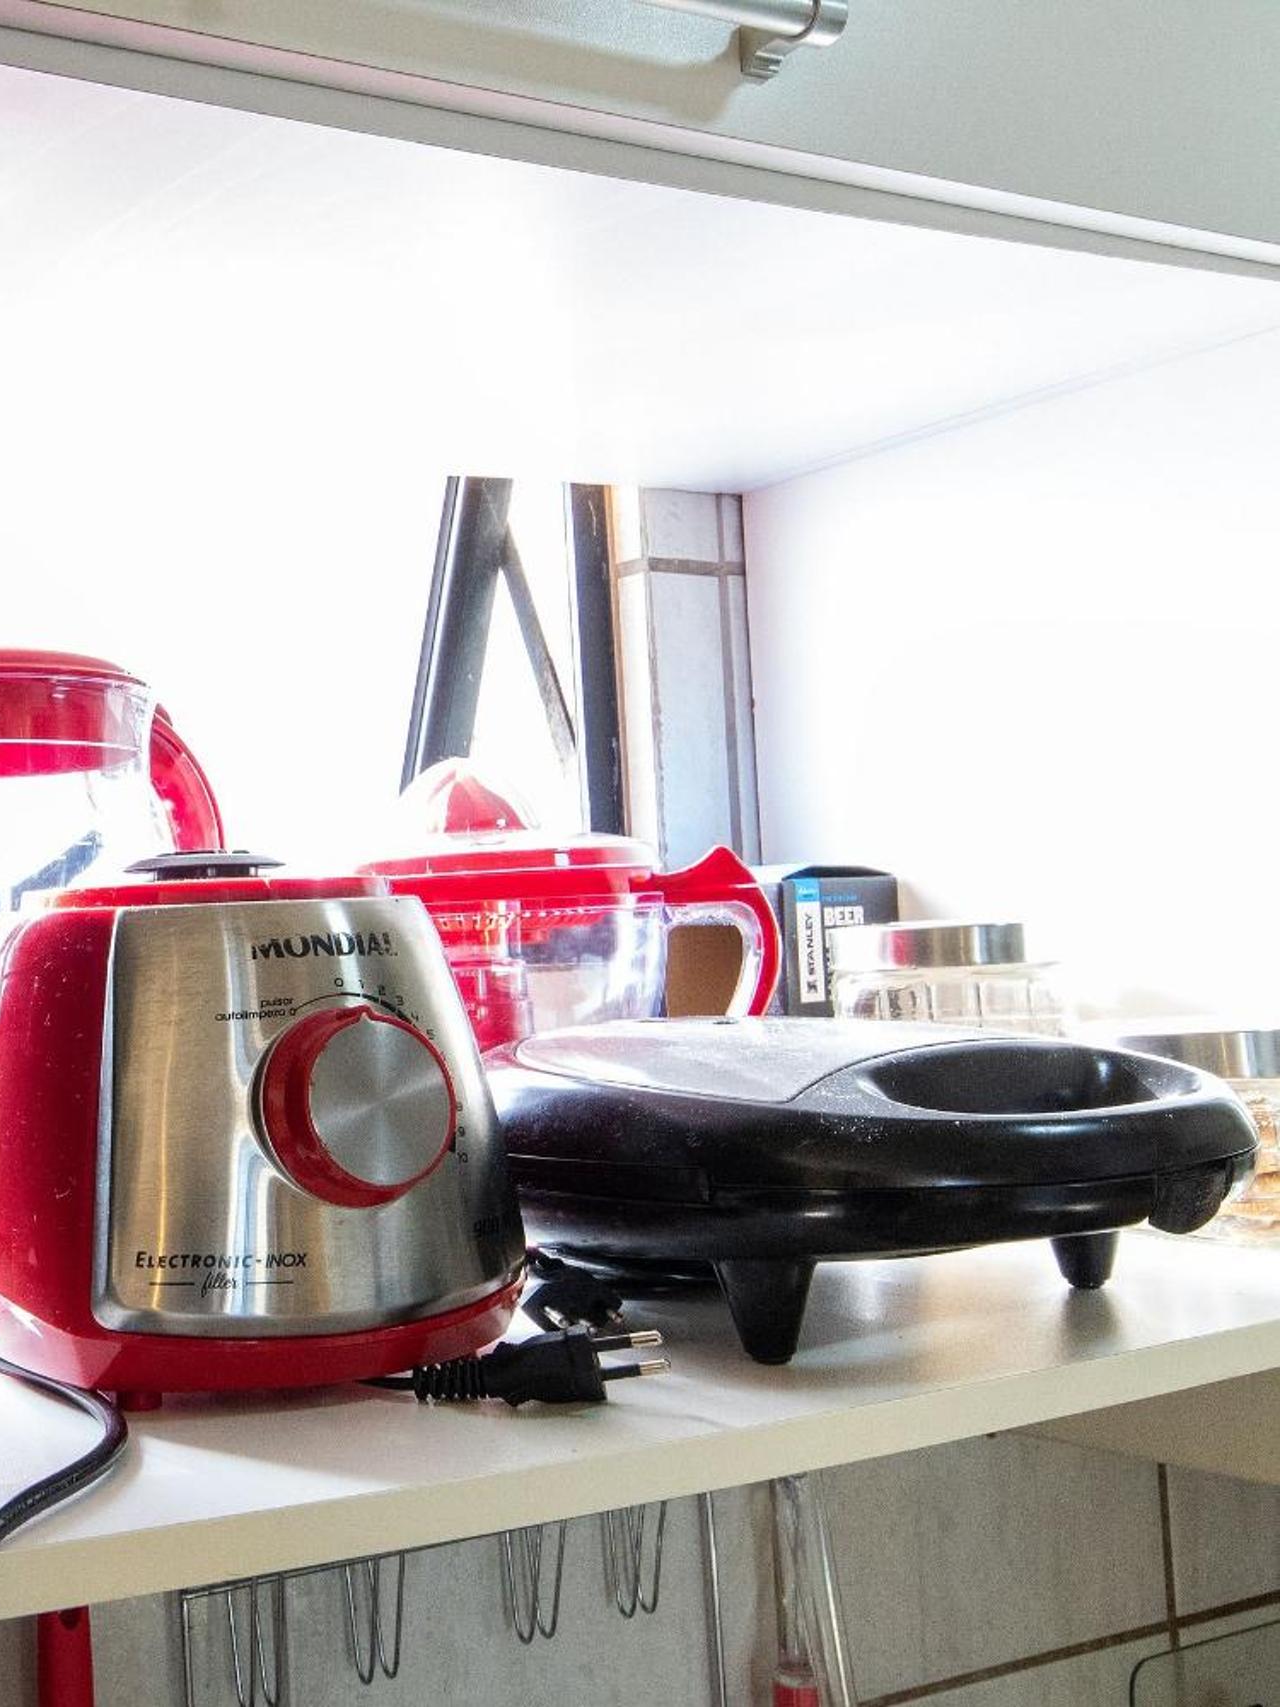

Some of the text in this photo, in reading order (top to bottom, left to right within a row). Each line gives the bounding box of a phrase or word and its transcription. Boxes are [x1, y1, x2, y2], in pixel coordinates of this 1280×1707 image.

[805, 913, 816, 976] STANLEY
[334, 977, 344, 988] 0
[396, 995, 404, 1006] 3
[426, 1028, 436, 1041] 5
[457, 1126, 465, 1137] 9
